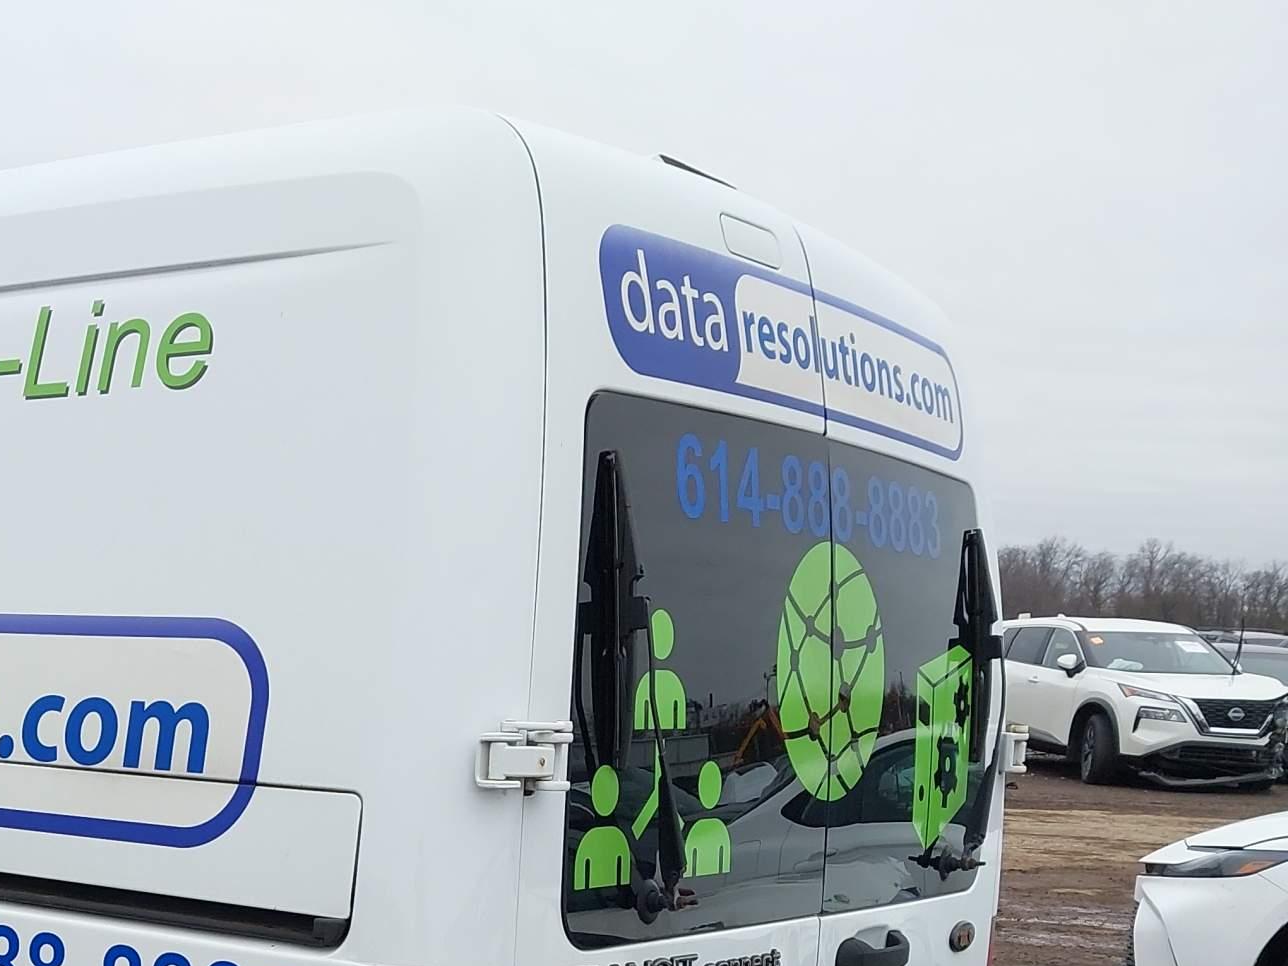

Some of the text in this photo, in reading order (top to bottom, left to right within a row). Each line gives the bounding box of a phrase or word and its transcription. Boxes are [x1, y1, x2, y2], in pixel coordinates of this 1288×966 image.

[619, 249, 955, 424] data resolutions.com
[675, 432, 942, 560] 614-888-8883
